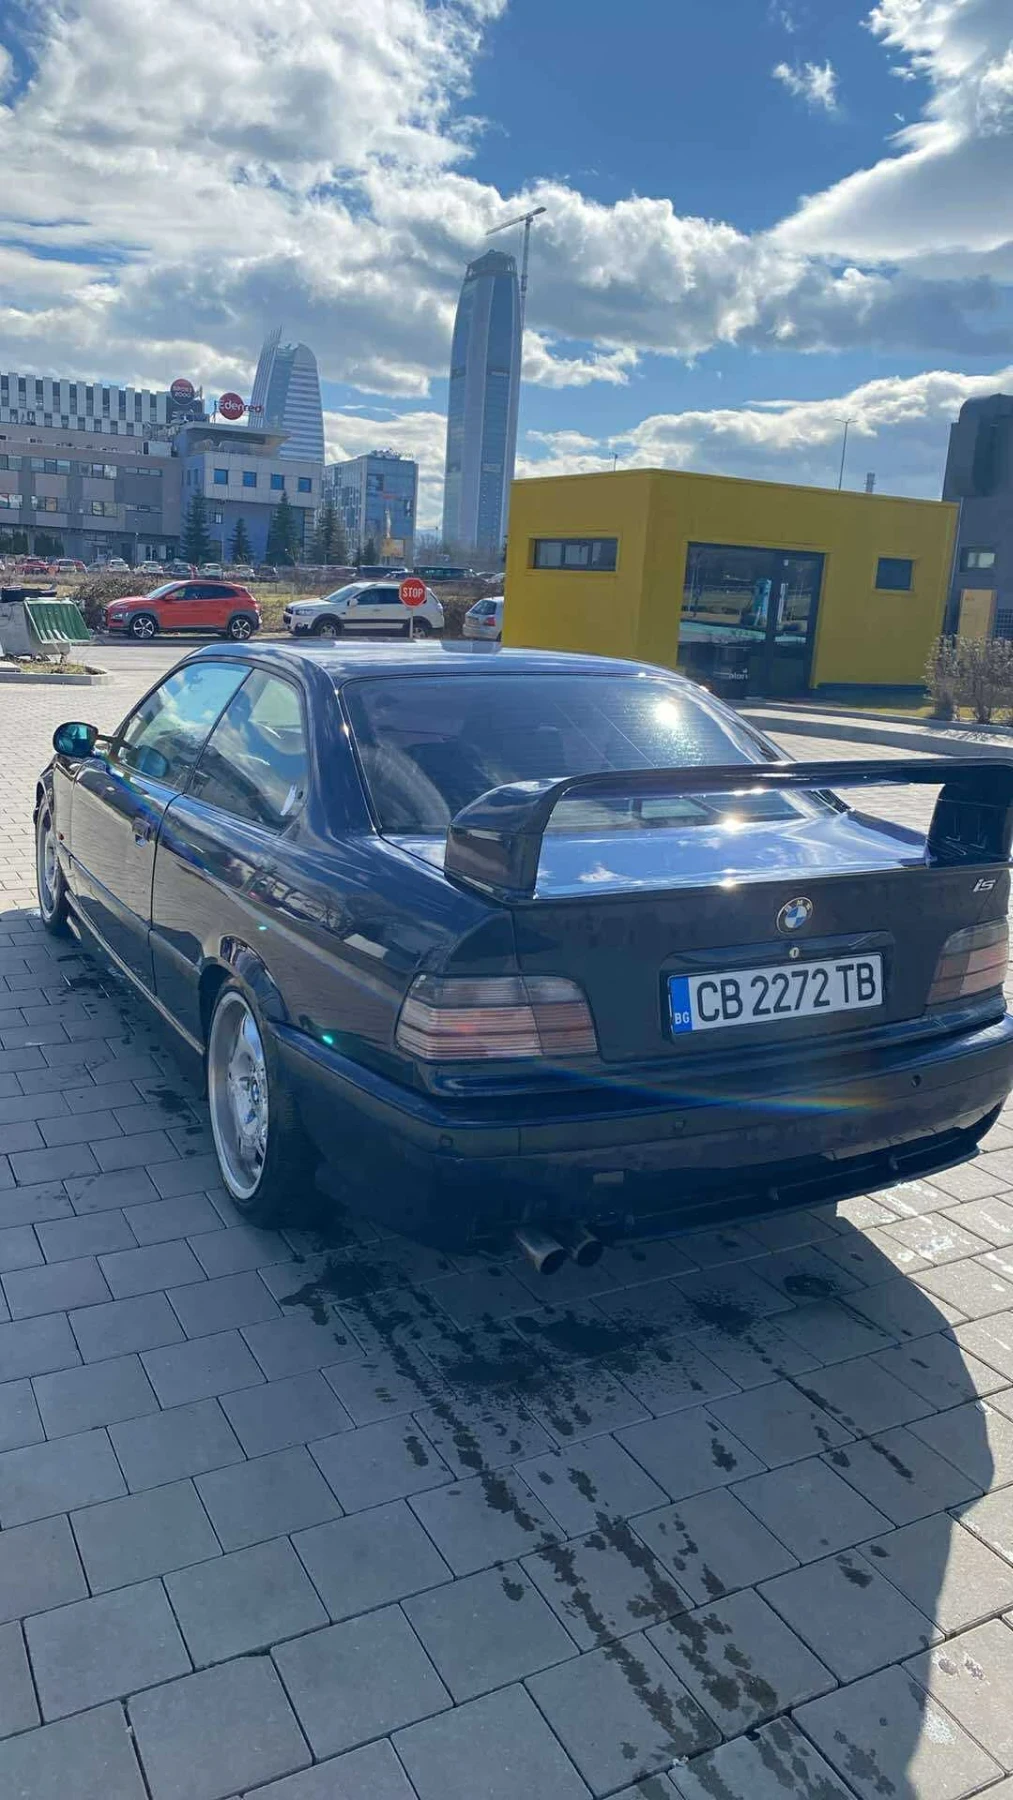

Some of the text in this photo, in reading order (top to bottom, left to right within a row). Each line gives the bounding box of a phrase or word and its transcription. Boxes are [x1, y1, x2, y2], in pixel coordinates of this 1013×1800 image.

[218, 400, 263, 413] Edenred
[402, 586, 424, 598] STOP
[696, 962, 877, 1022] CB 2272 TB
[674, 1011, 690, 1025] BG
